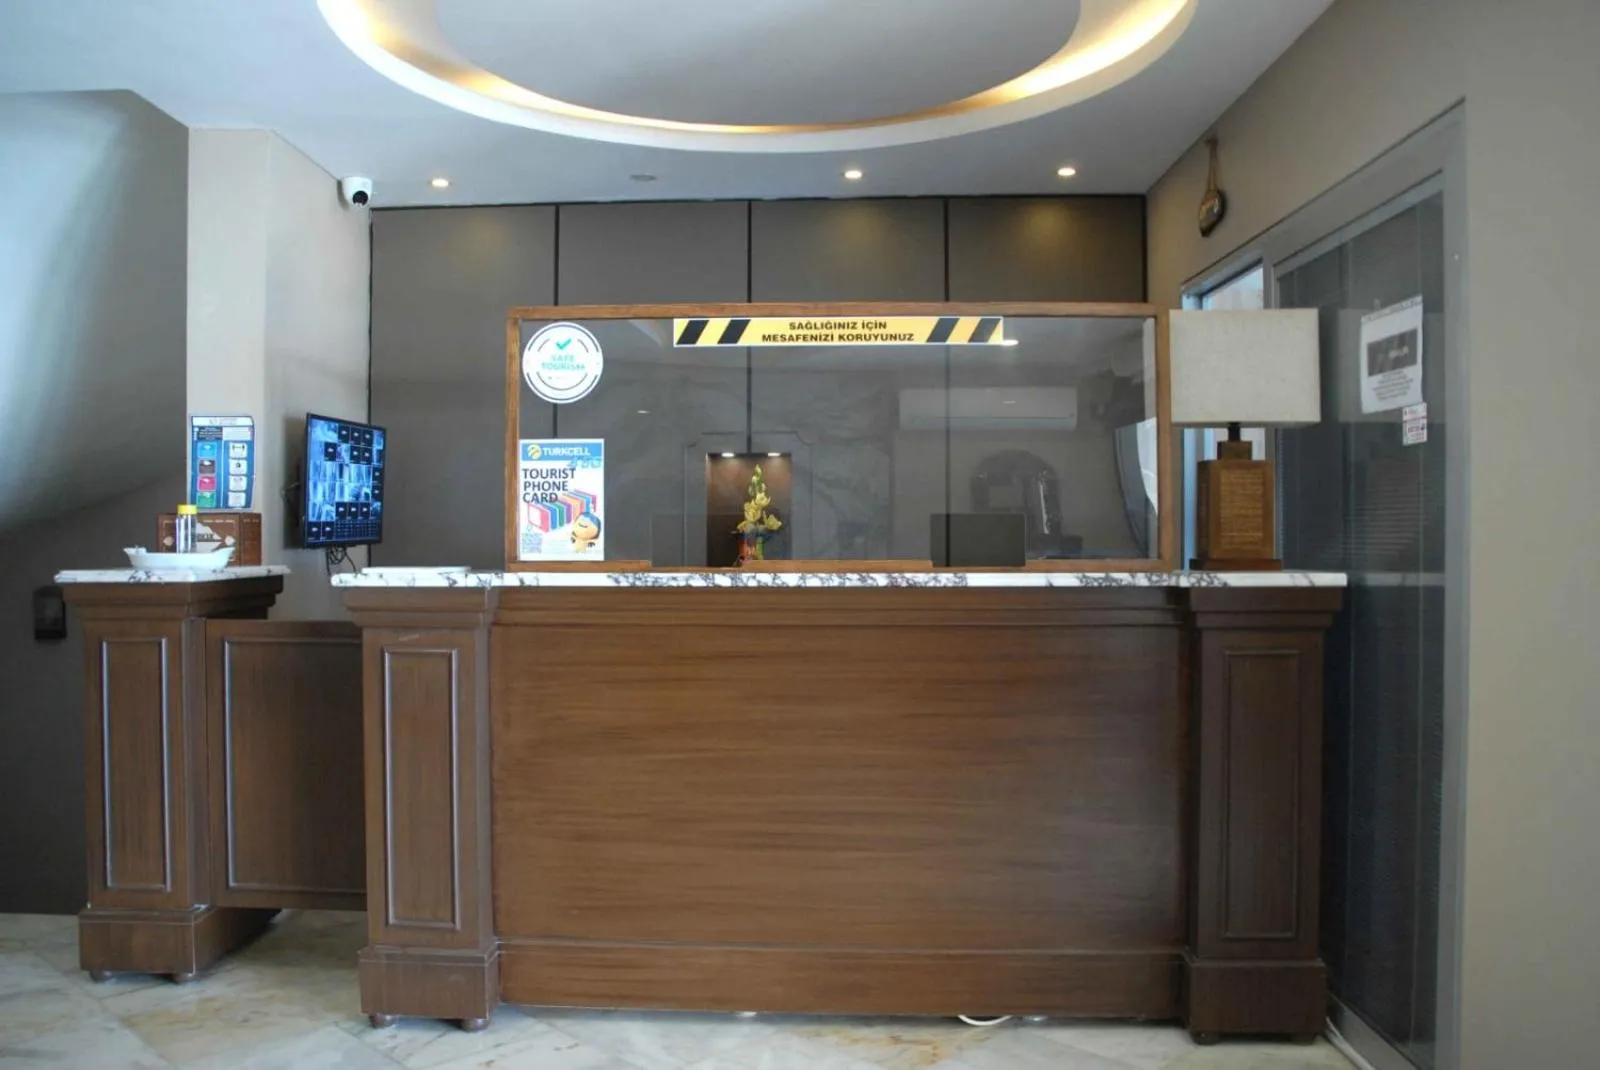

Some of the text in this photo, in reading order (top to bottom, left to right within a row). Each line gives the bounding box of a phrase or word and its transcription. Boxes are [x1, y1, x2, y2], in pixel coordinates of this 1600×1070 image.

[789, 320, 887, 331] SAĞLIĞINIZ İÇİN
[762, 332, 915, 342] MESAFENİZİ KORUYUNUZ
[542, 447, 592, 457] TURKCELL
[522, 468, 577, 479] TOURIST
[523, 480, 569, 492] PHONE
[522, 492, 559, 504] CARD
